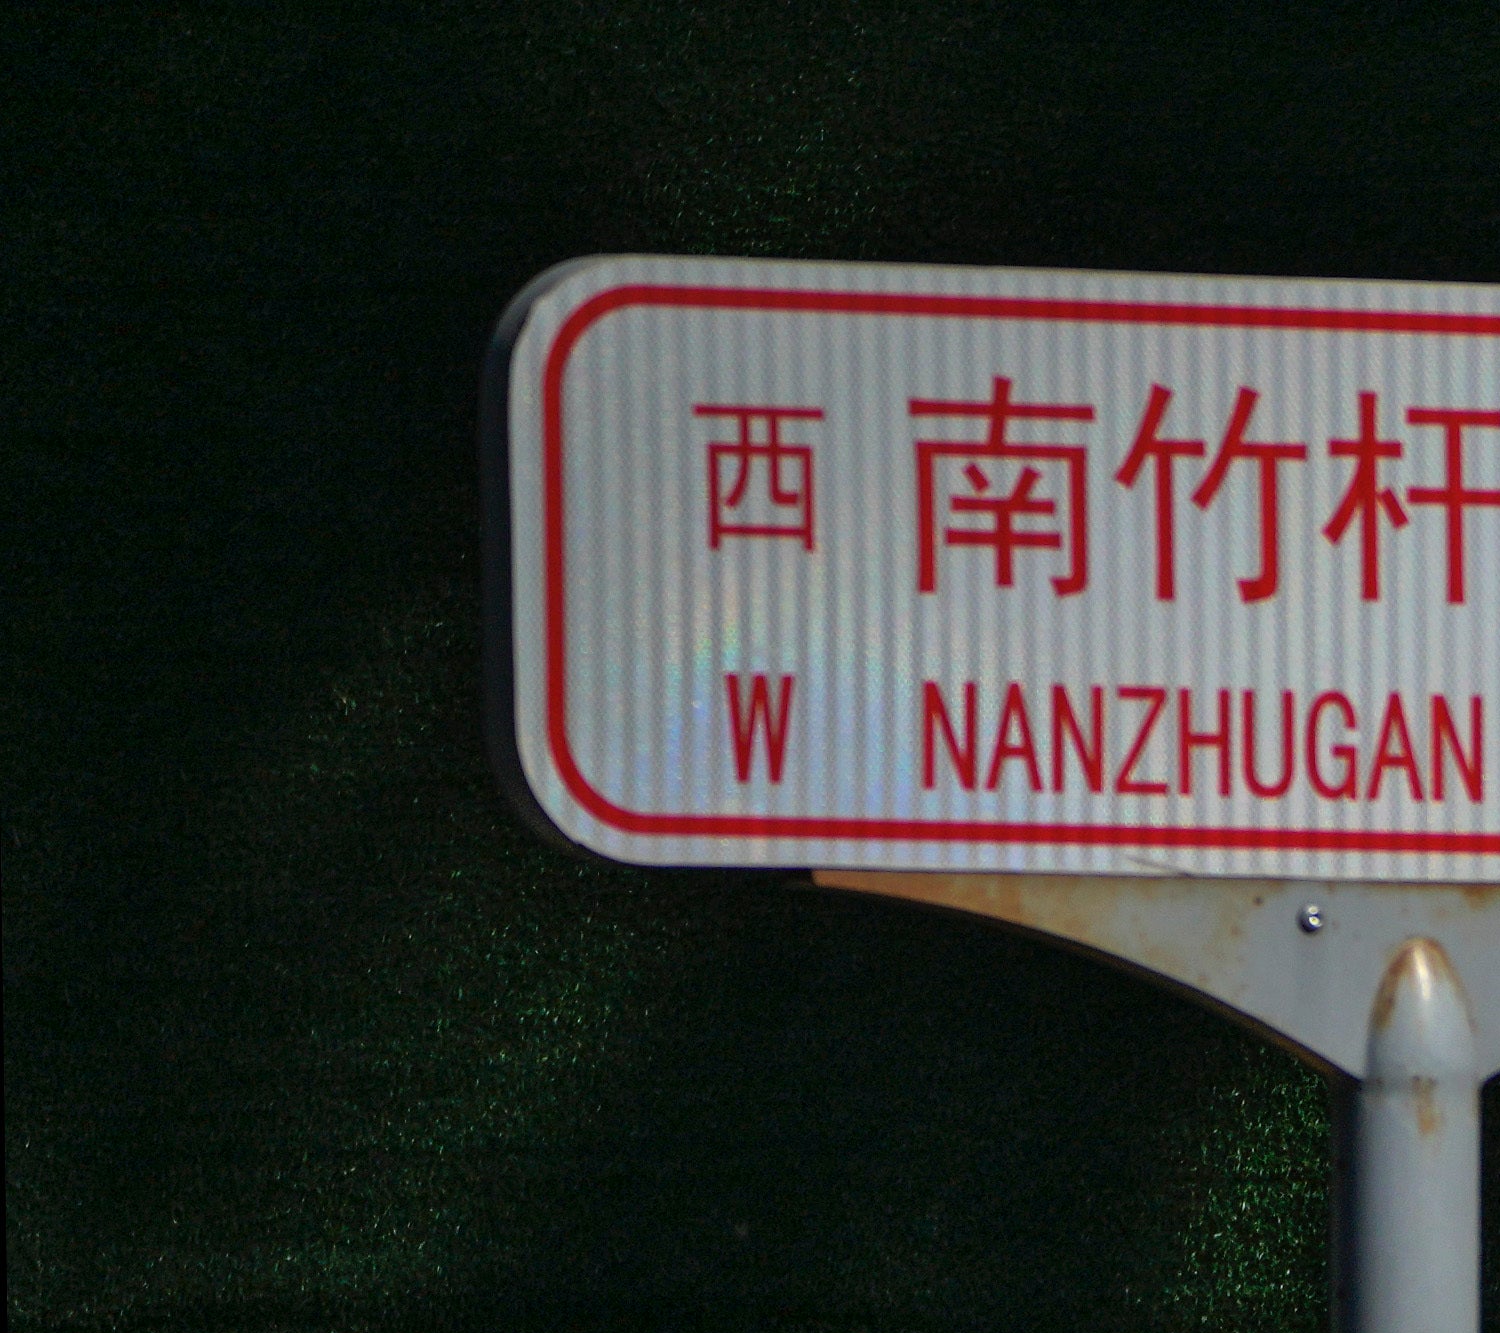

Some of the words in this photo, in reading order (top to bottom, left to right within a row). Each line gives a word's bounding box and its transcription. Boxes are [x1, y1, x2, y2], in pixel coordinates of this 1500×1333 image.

[694, 405, 823, 550] 西
[726, 674, 793, 783] W
[923, 681, 1483, 802] NANZHUGAN
